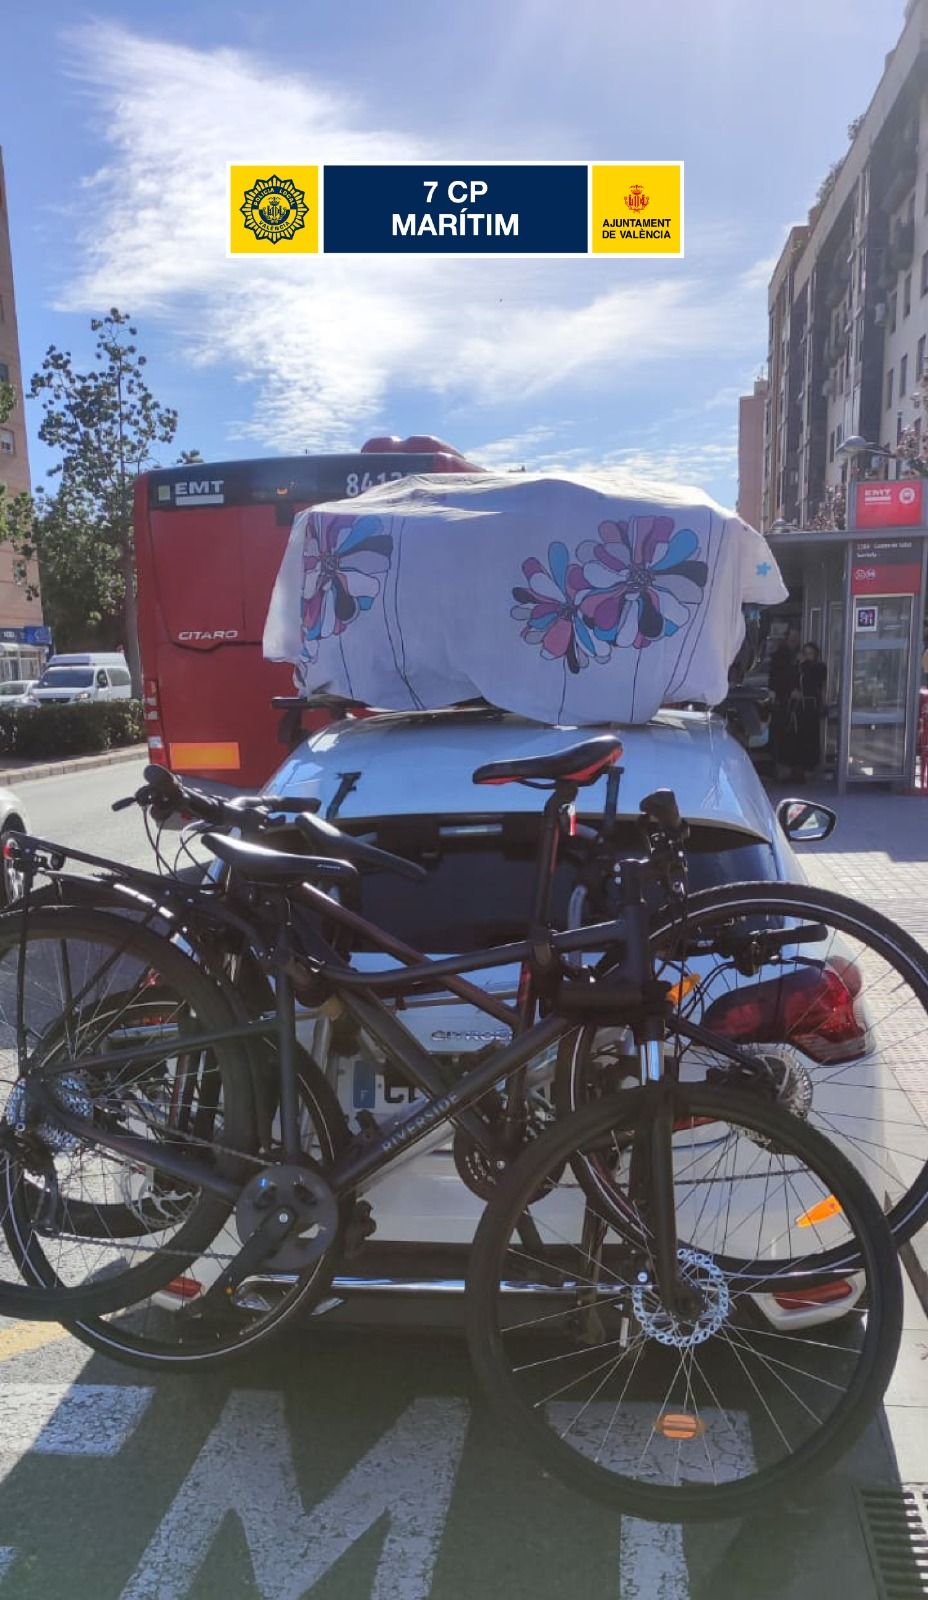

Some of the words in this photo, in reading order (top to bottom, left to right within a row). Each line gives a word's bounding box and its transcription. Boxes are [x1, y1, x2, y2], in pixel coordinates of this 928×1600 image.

[175, 480, 225, 495] EMT
[178, 630, 239, 641] CITARO
[381, 1091, 458, 1152] RIVERSIDE
